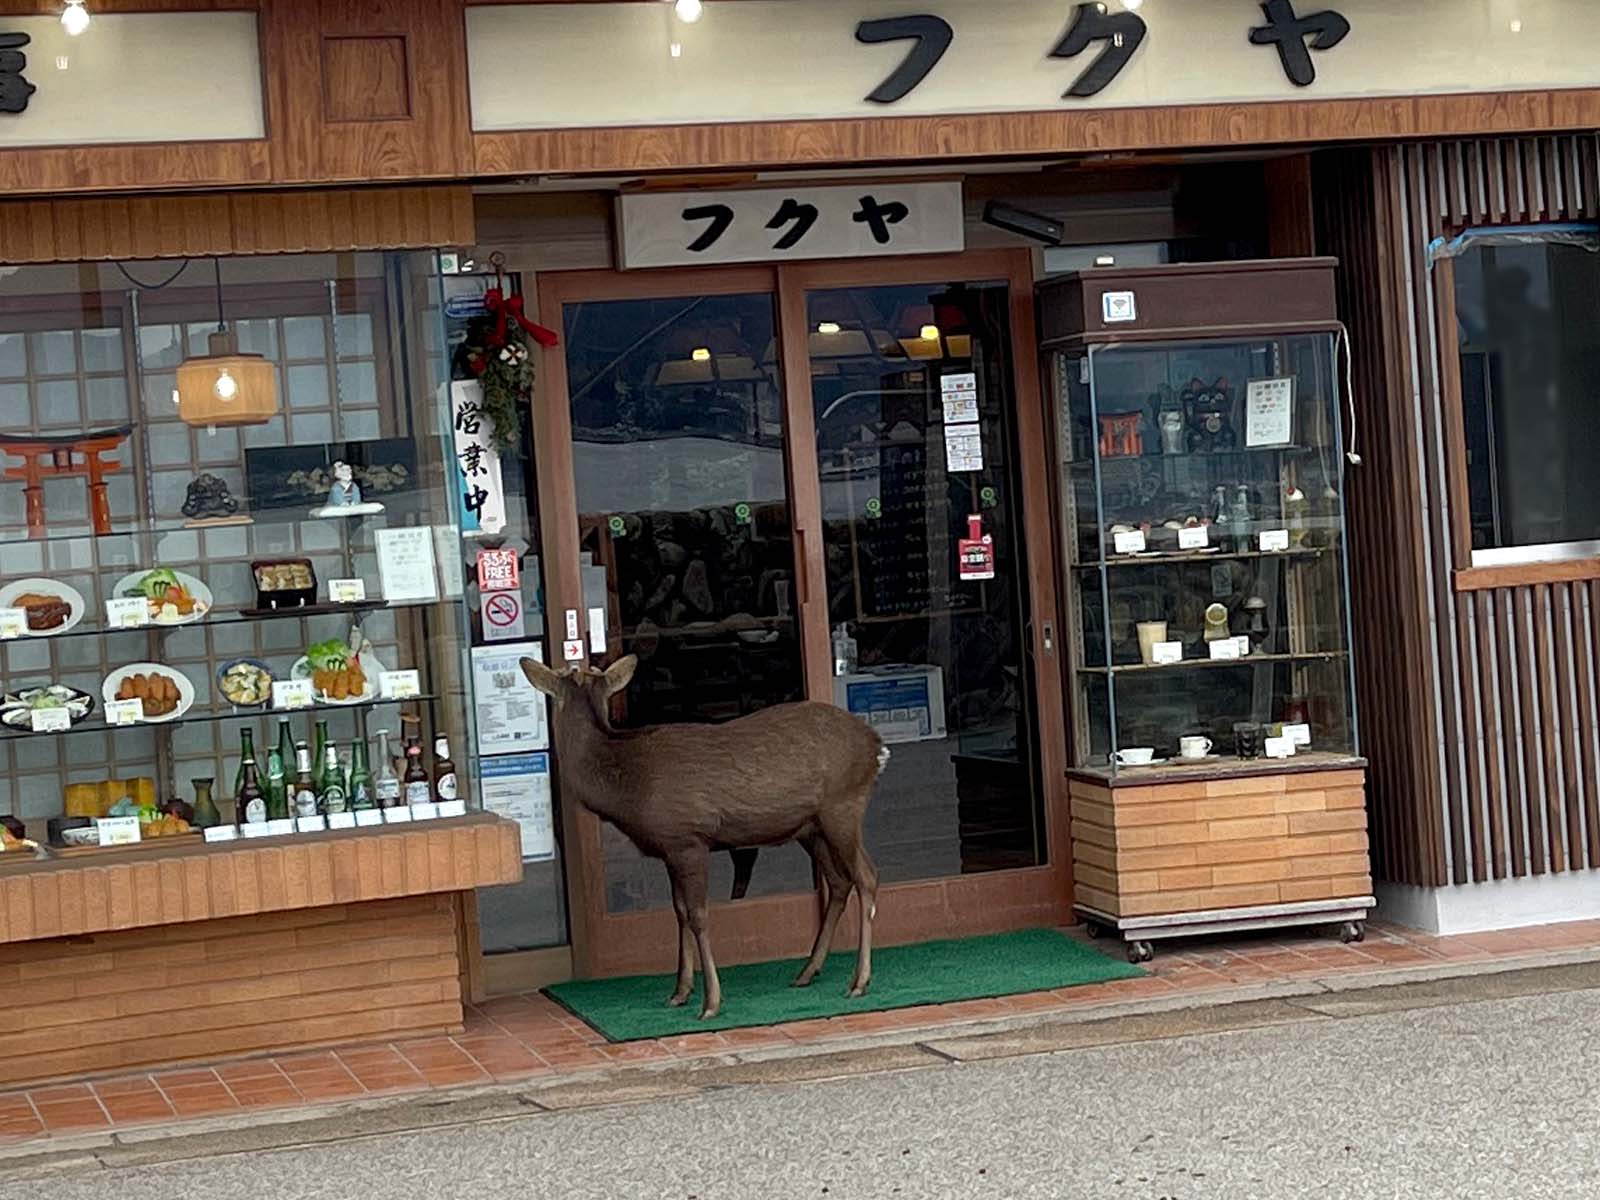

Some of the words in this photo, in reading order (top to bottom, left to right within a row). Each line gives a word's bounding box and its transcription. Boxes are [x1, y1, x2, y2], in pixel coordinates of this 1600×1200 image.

[855, 0, 1350, 103] フクヤ
[682, 195, 908, 251] フクヤ
[456, 401, 489, 523] 営業中
[485, 565, 513, 580] FREE
